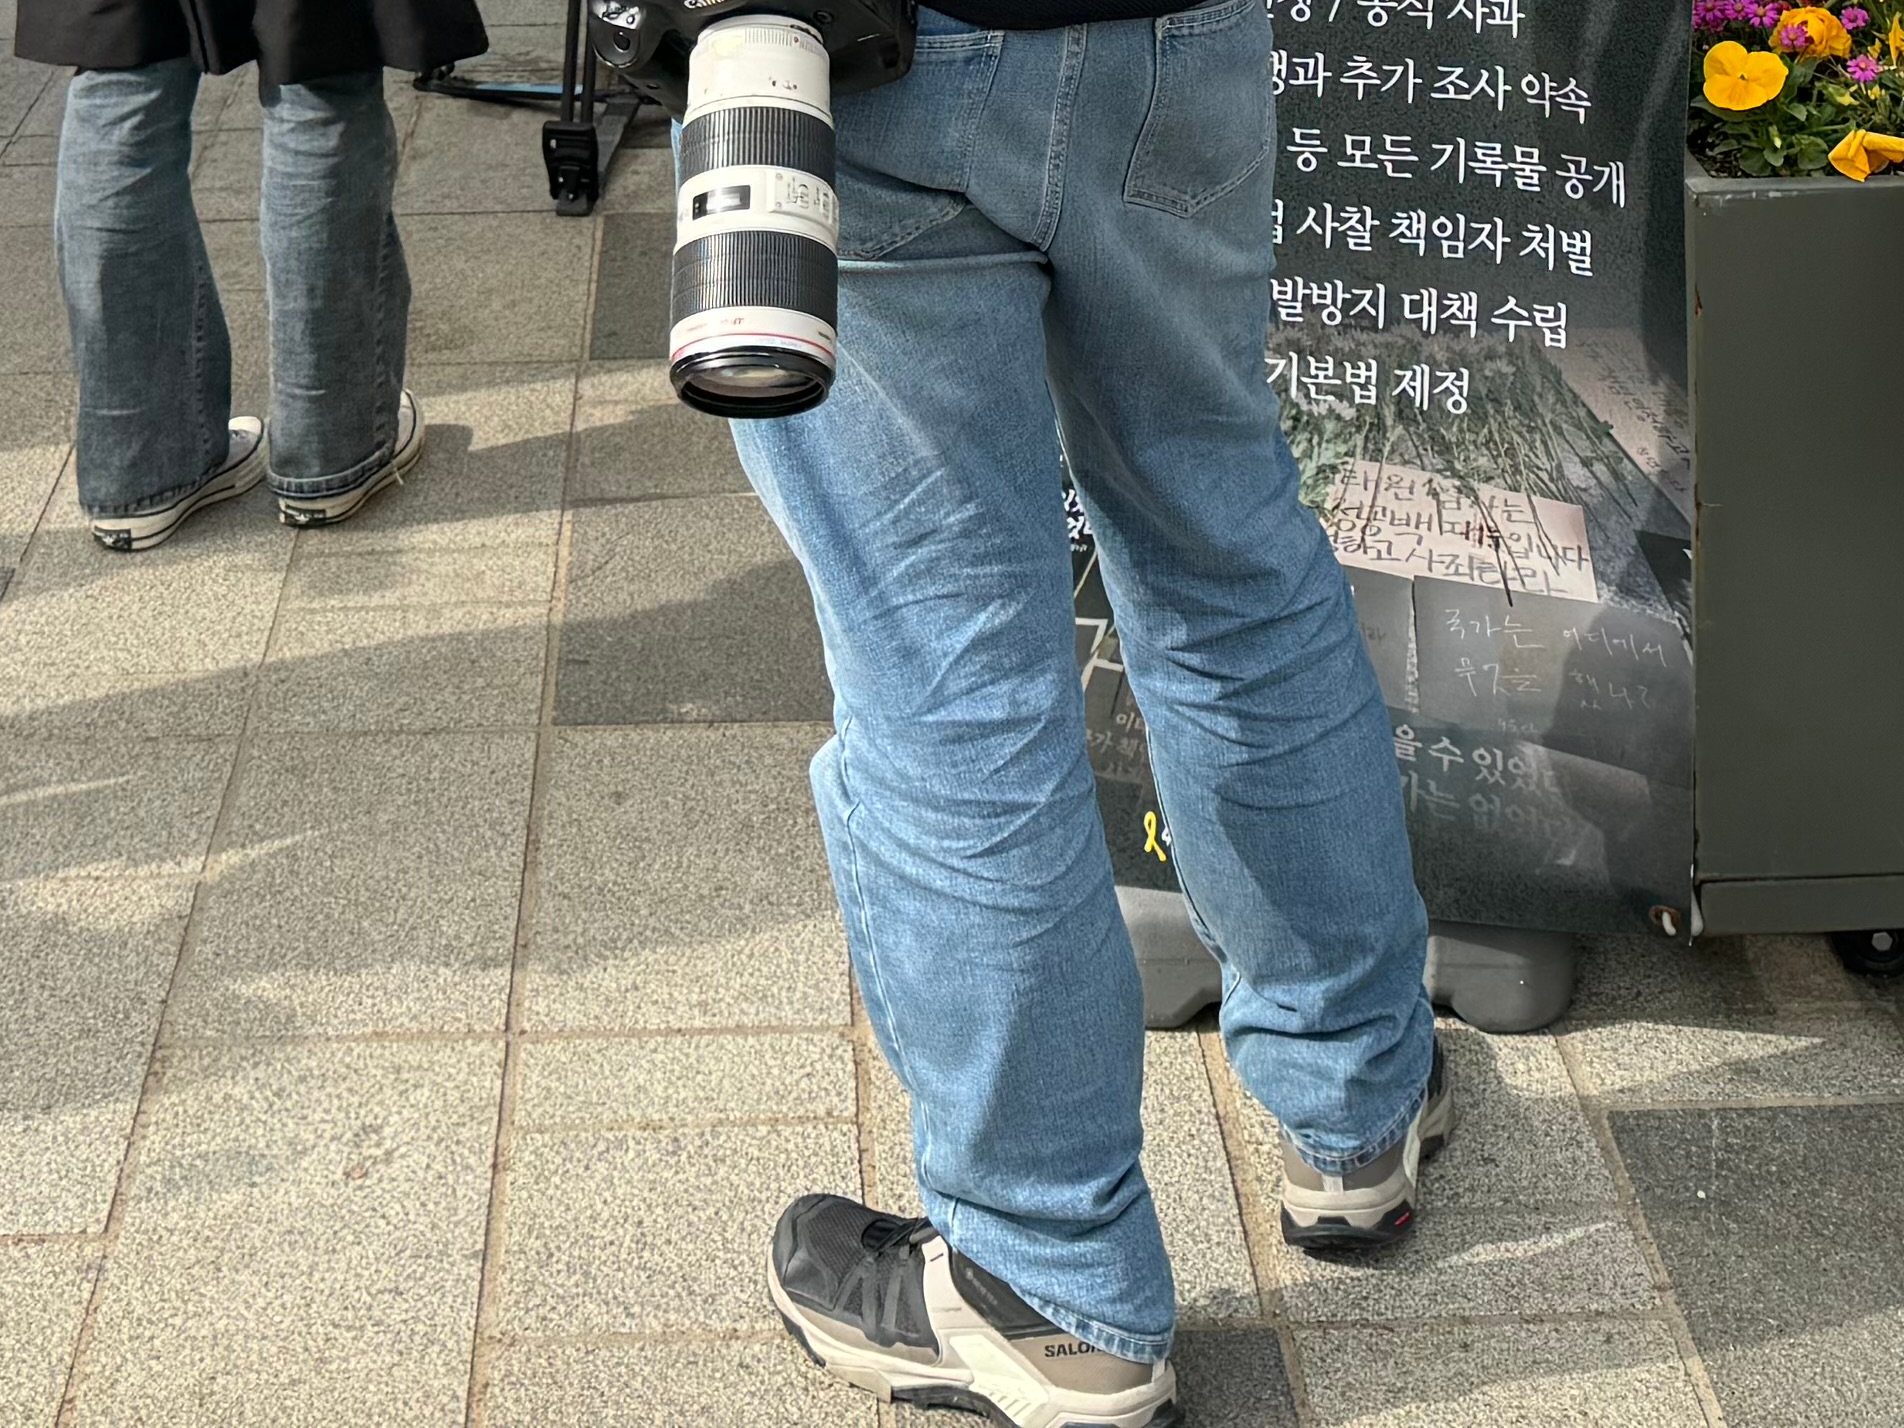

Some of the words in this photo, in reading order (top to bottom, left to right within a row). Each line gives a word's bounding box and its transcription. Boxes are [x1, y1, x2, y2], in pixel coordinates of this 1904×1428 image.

[1339, 55, 1424, 105] 추가
[1430, 63, 1512, 112] 조사
[1520, 71, 1593, 125] 약속
[1286, 127, 1329, 174] 등
[1336, 132, 1420, 179] 모든
[1430, 137, 1548, 194] 기록물
[1554, 153, 1627, 209] 공개
[1296, 203, 1382, 253] 사찰
[1388, 211, 1512, 266] 책임자
[1519, 222, 1595, 278] 처벌
[1270, 277, 1387, 330] 발방지
[1400, 287, 1479, 339] 대책
[1490, 294, 1570, 350] 수립
[1263, 352, 1379, 406] 기본법
[1392, 363, 1471, 416] 제정
[1044, 1342, 1106, 1359] SALO
